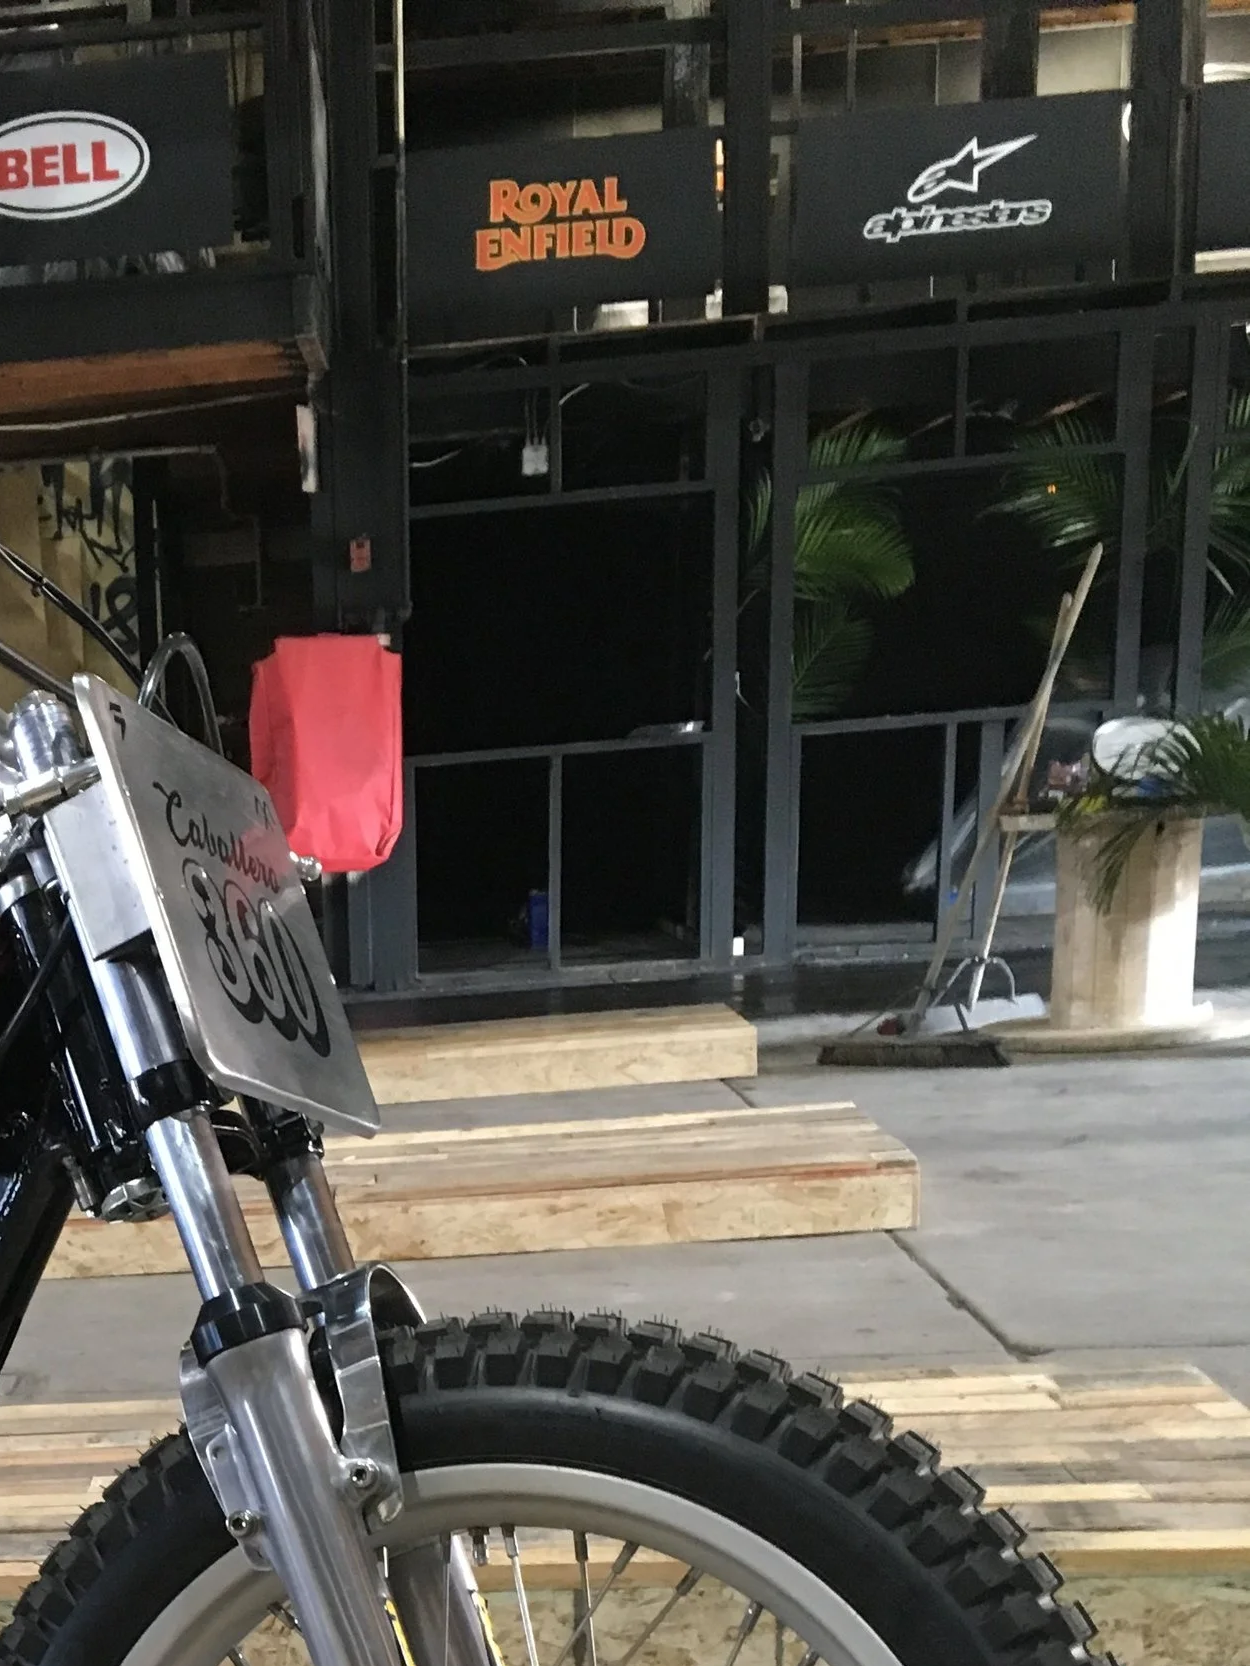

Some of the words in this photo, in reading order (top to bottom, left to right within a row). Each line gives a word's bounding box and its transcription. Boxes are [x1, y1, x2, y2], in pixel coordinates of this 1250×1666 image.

[489, 176, 628, 224] ROYAL
[862, 199, 1052, 243] alpinestars
[475, 216, 646, 271] ENFIELD
[152, 781, 280, 893] Caballero
[183, 857, 332, 1058] 360
